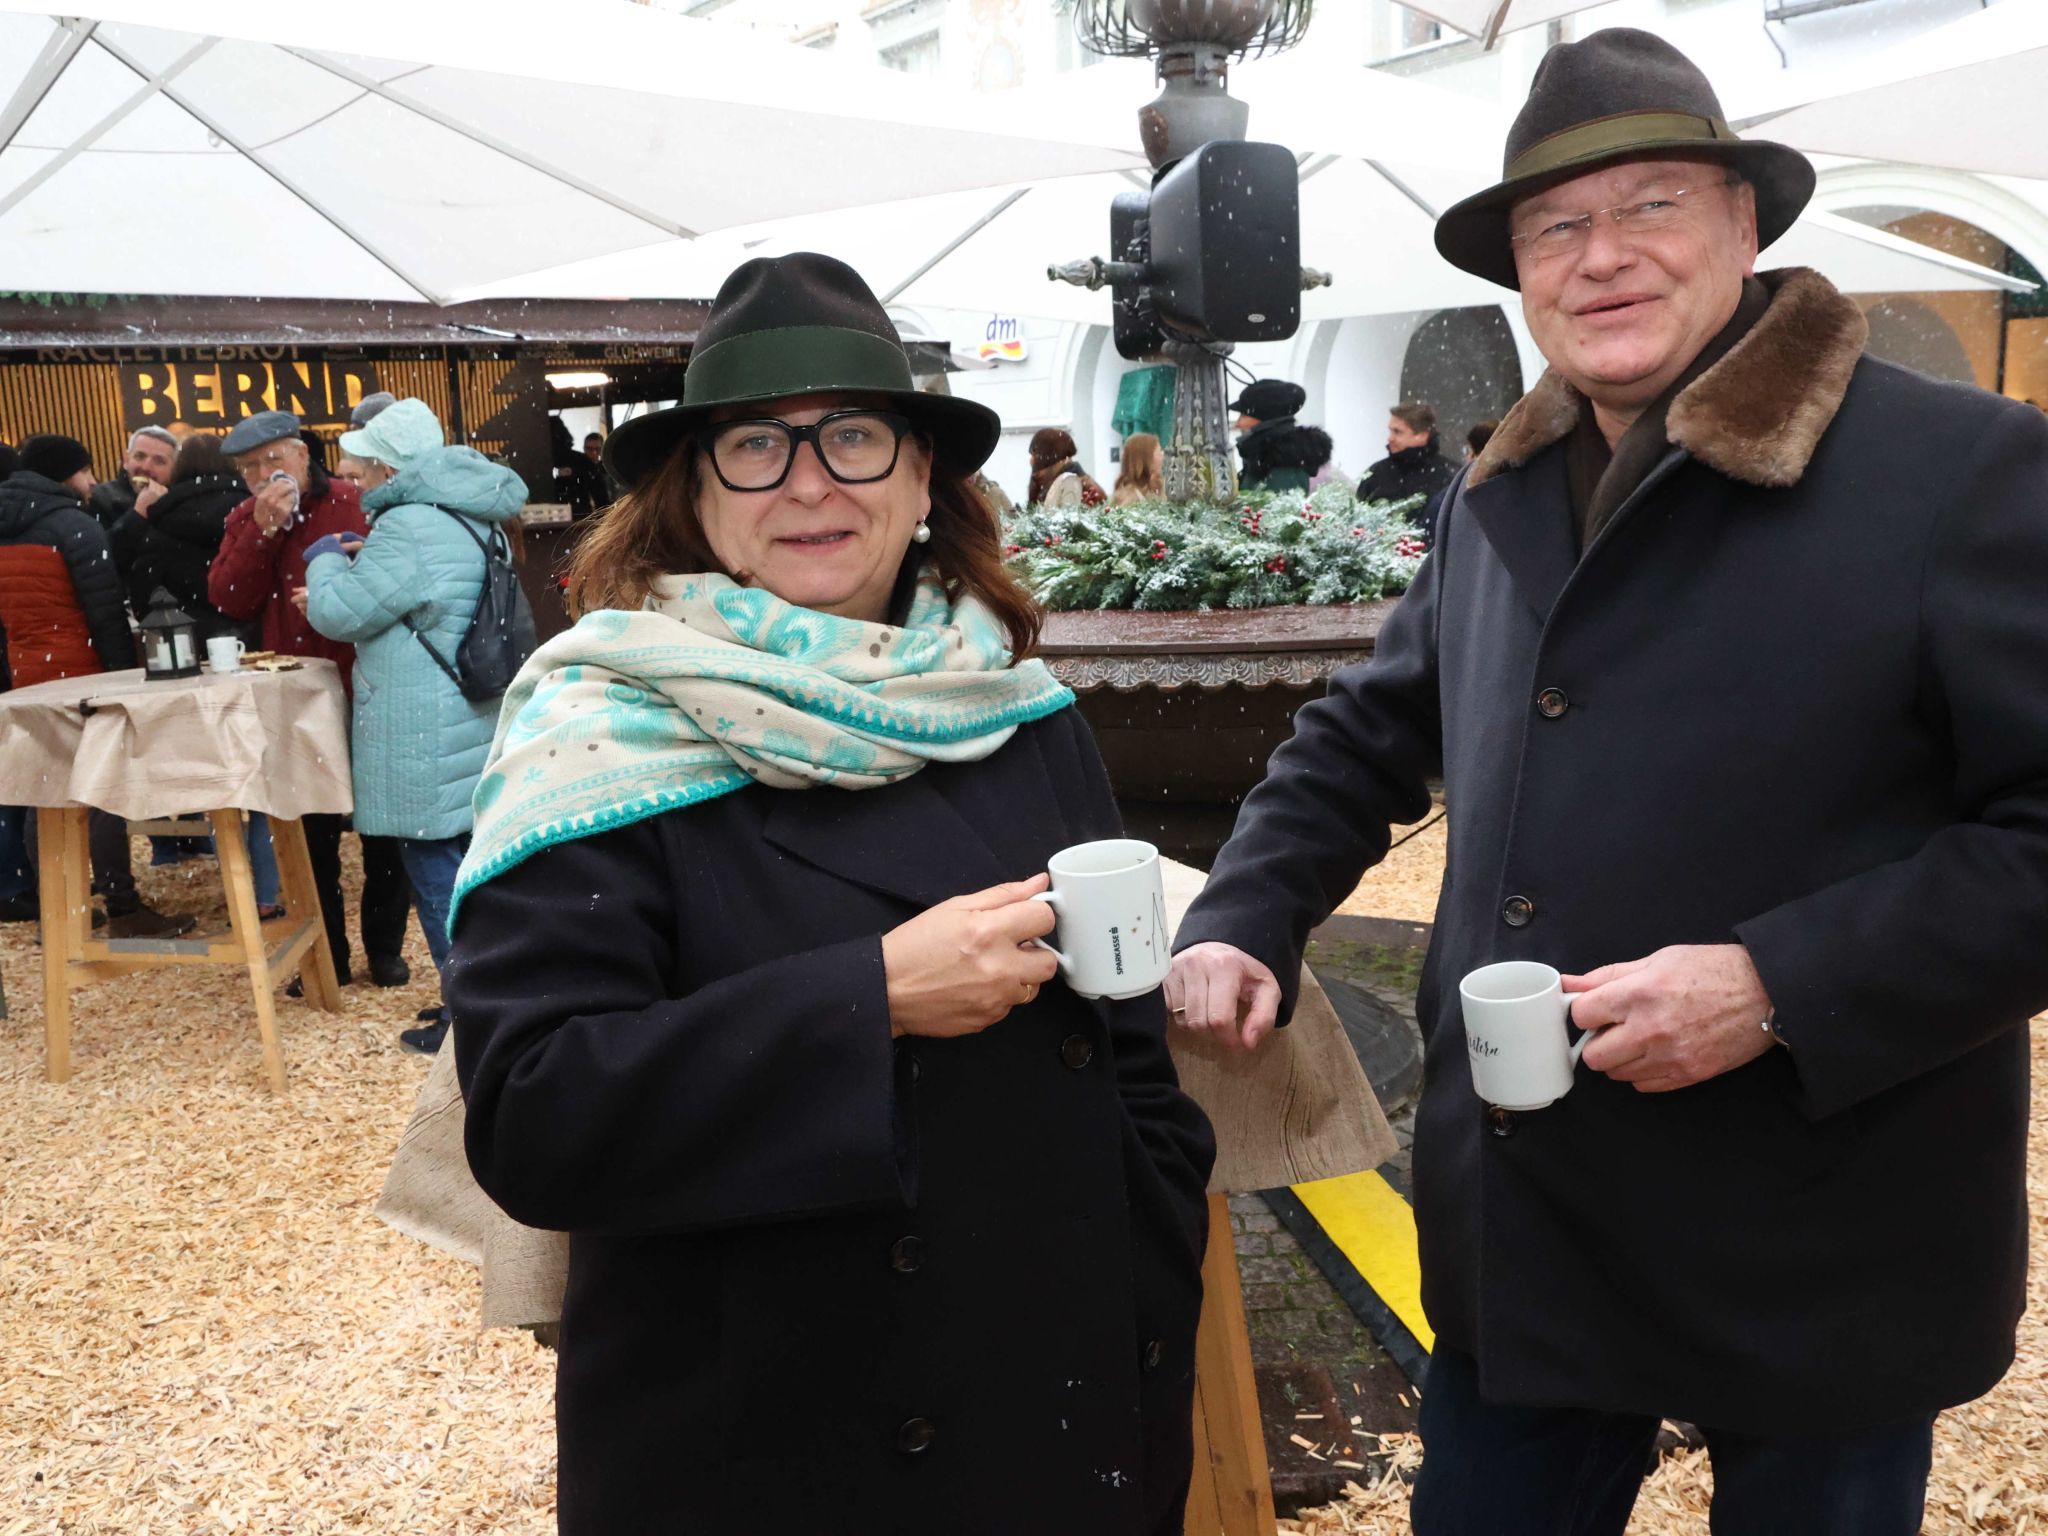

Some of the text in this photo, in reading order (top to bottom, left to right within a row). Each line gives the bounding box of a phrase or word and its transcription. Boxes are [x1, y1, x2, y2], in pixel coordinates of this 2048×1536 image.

[986, 312, 1017, 341] dm
[128, 361, 372, 425] BERND
[1112, 934, 1124, 976] SPARKASSE
